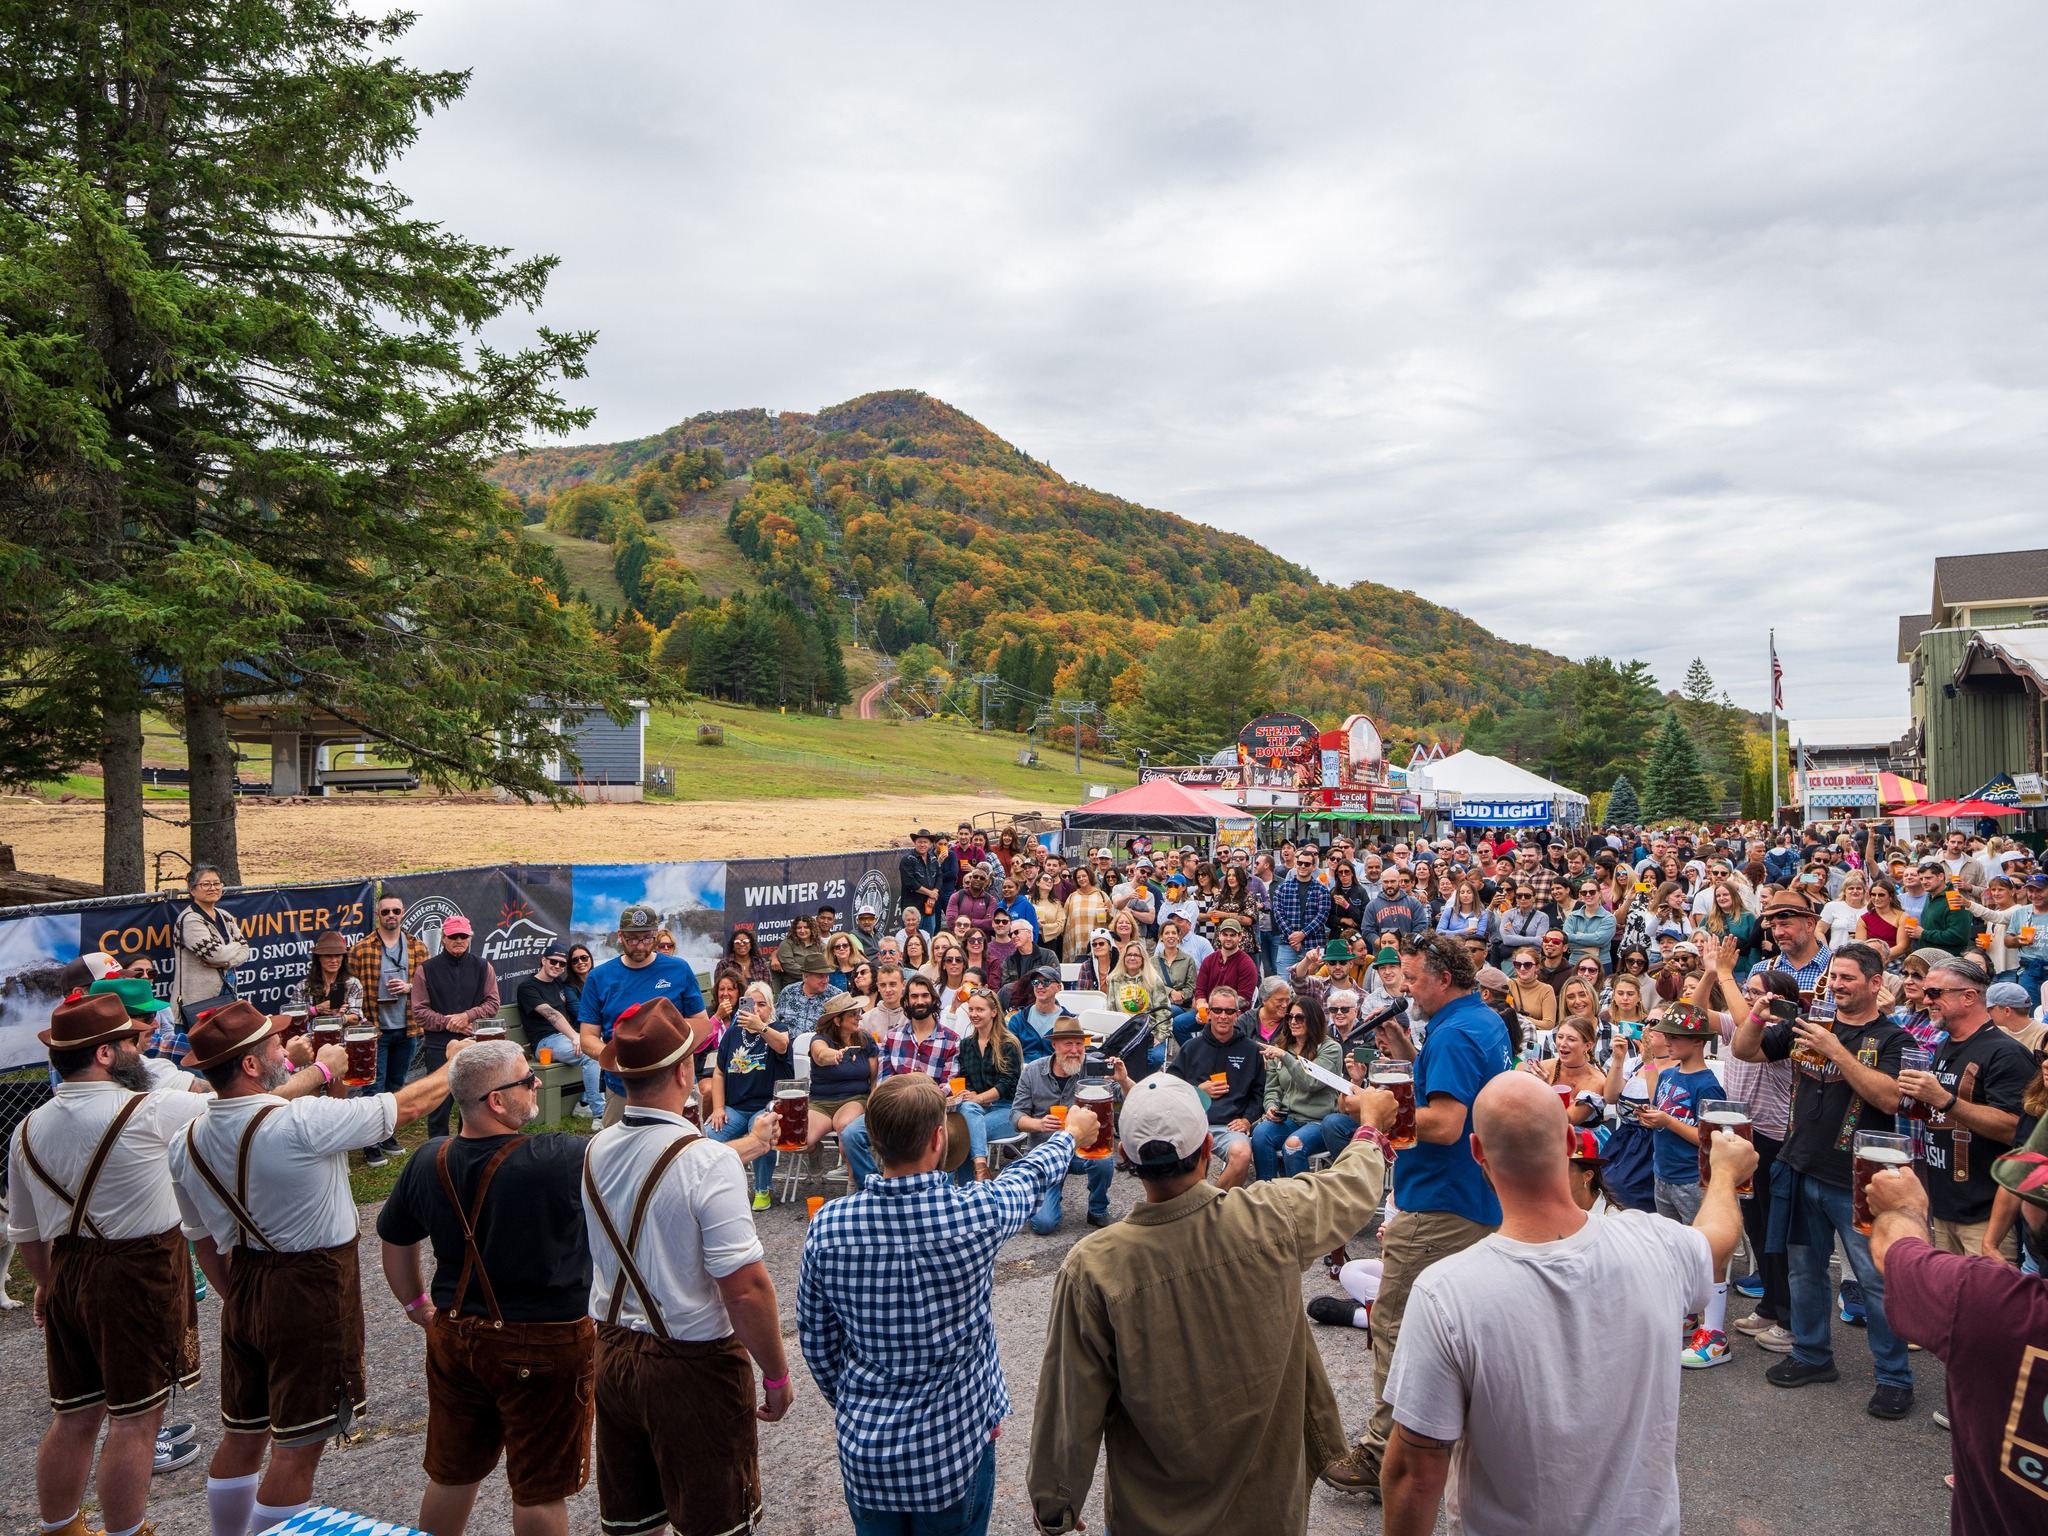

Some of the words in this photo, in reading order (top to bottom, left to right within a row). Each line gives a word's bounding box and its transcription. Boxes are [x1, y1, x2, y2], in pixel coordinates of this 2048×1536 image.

[1256, 725, 1301, 737] STEAK
[1267, 737, 1289, 747] TIP
[1256, 746, 1301, 757] BOWLS
[1178, 769, 1212, 783] Chicken
[1215, 768, 1241, 782] Pitas
[1809, 777, 1821, 787] ICE
[1823, 776, 1843, 786] COLD
[1846, 775, 1874, 786] DRINKS
[1340, 793, 1349, 801] Ice
[1351, 793, 1367, 801] Cold
[1454, 804, 1491, 817] BUD
[1493, 803, 1544, 818] LIGHT
[744, 881, 819, 907] WINTER
[402, 904, 436, 931] Hunter
[1376, 905, 1412, 923] VIRGINIA
[98, 924, 171, 956] COM
[233, 908, 330, 938] WINTER
[481, 937, 558, 961] Hunter
[500, 947, 546, 961] mountai
[260, 986, 281, 1003] TO
